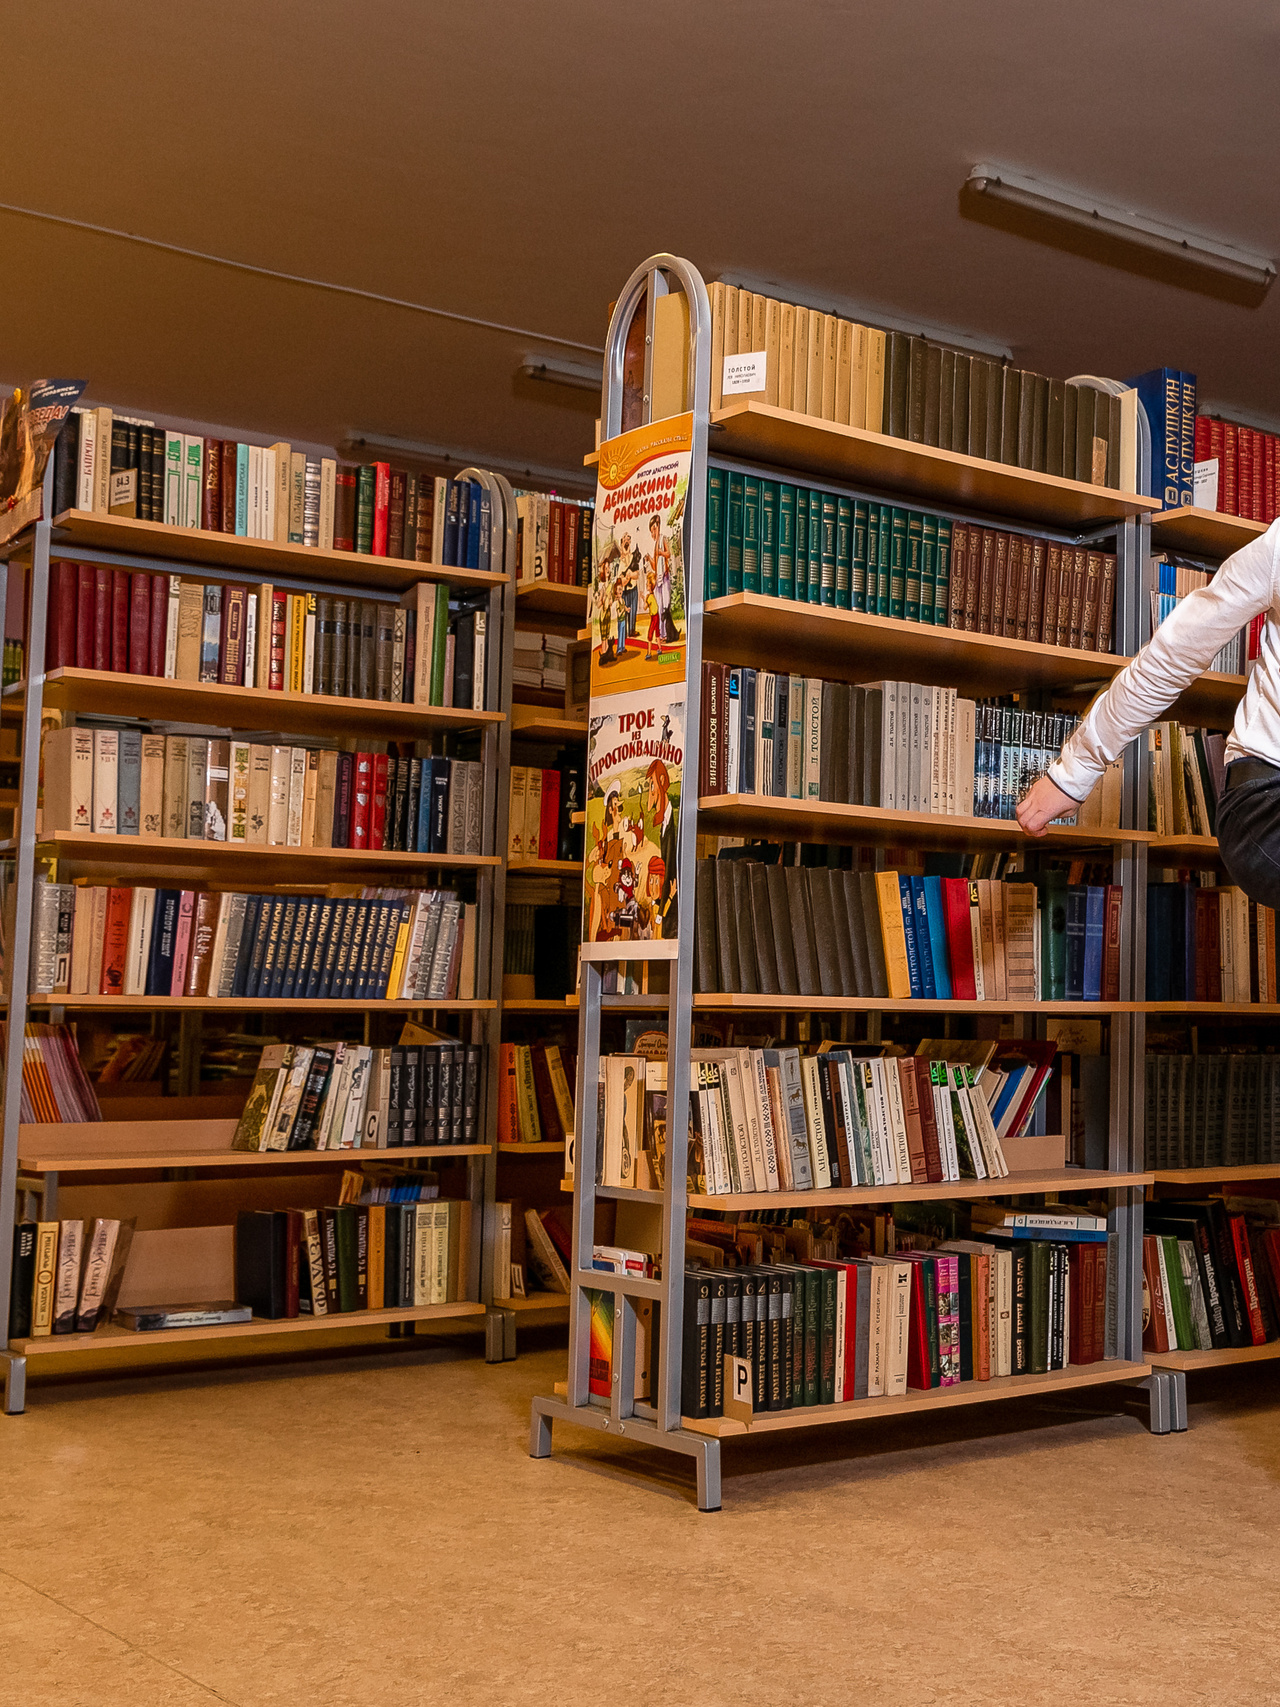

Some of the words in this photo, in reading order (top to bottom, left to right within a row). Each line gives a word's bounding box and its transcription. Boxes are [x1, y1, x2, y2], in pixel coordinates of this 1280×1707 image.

[728, 364, 756, 373] ТОЛСТОЙ
[83, 439, 93, 475] БАЙРОН
[116, 475, 130, 487] 84.3
[238, 463, 246, 496] БАВАРСКАЯ
[602, 472, 678, 513] ДЕНИСКИНЫ
[613, 491, 676, 525] РАССКАЗЫ
[535, 556, 543, 578] В
[618, 708, 655, 735] ТРОЕ
[631, 730, 642, 744] ИЗ
[811, 697, 819, 752] ТОЛСТОЙ
[589, 737, 684, 782] ПРОСТОКВАШИНО
[709, 718, 718, 787] ВОСКРЕСЕНИЕ
[163, 899, 174, 931] ЛОНДОН
[281, 903, 295, 942] ЛОНДОН
[317, 905, 332, 942] ЛОНДОН
[330, 905, 344, 942] ЛОНДОН
[342, 906, 356, 944] ЛОНДОН
[354, 906, 367, 944] ЛОНДОН
[386, 908, 399, 946] ЛОНДОН
[161, 932, 171, 956] ДЖЕК
[288, 944, 300, 970] ДЖЕК
[294, 904, 308, 942] ЛОНДОН
[371, 946, 381, 972] ДЖЕК
[376, 907, 389, 944] ЛОНДОН
[56, 957, 67, 983] Л
[277, 943, 287, 970] ДЖЕК
[312, 944, 323, 971] ДЖЕК
[326, 944, 336, 969] ДЖЕК
[338, 945, 350, 972] ДЖЕК
[349, 945, 360, 971] ДЖЕК
[381, 947, 393, 973] ДЖЕК
[366, 1115, 377, 1139] С
[1016, 1257, 1025, 1298] АРБАТА
[1108, 1240, 1117, 1286] РЫБАКОВ
[700, 1285, 709, 1299] 9
[717, 1284, 726, 1297] 8
[732, 1283, 740, 1296] 7
[746, 1282, 754, 1295] 6
[758, 1282, 766, 1294] 4
[772, 1281, 779, 1293] 3
[787, 1282, 793, 1293] 1
[1203, 1253, 1219, 1306] Проскурин
[1244, 1258, 1258, 1310] Проскурин
[1108, 1291, 1117, 1349] АНАТОЛИЙ
[737, 1364, 748, 1396] Р
